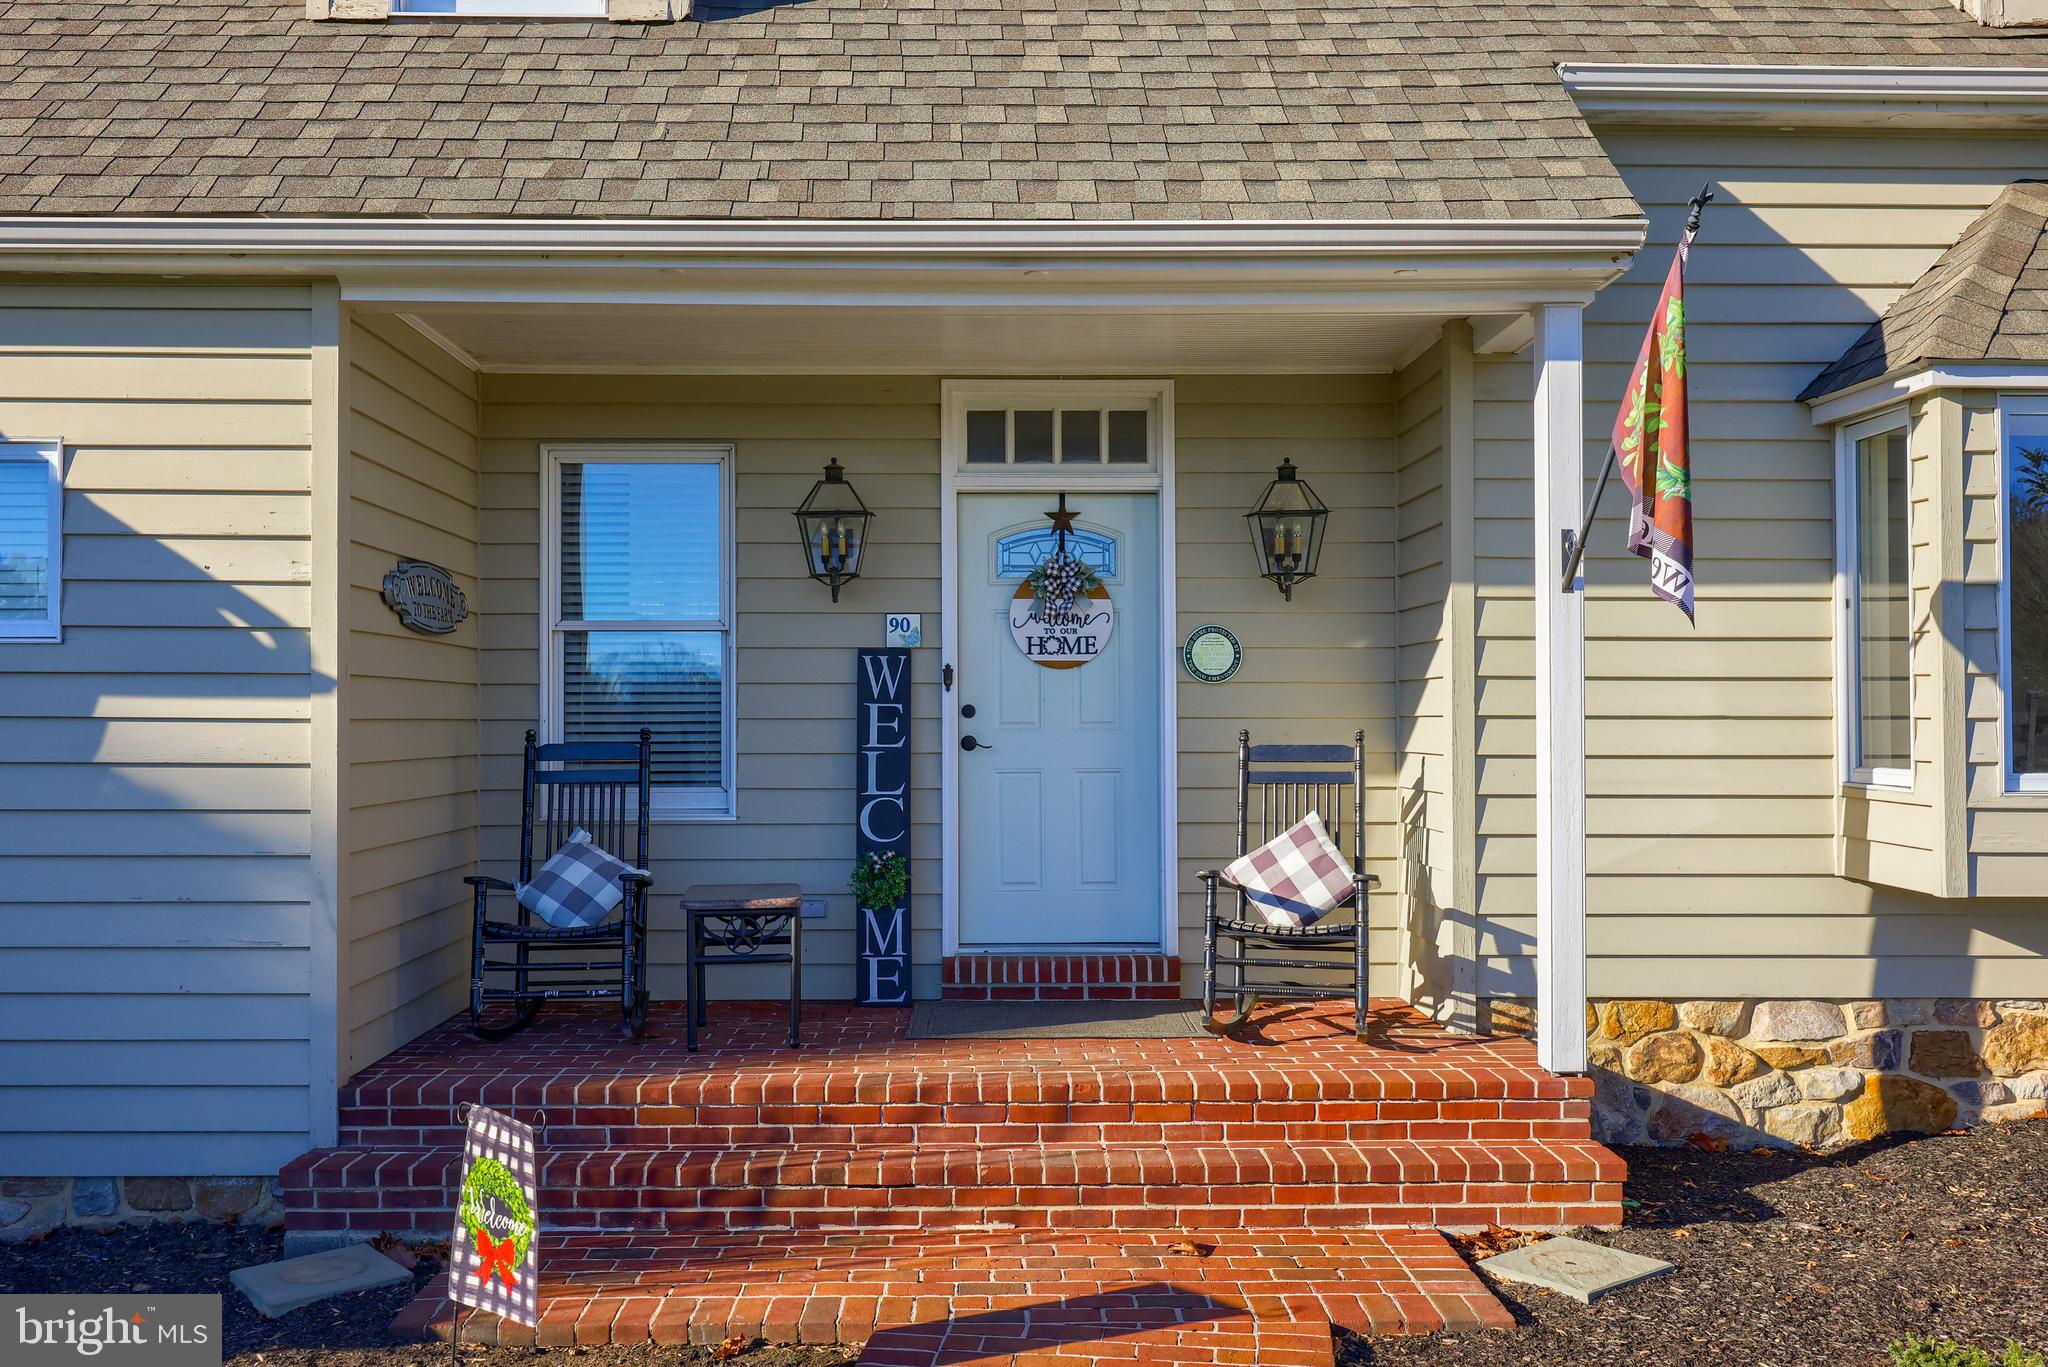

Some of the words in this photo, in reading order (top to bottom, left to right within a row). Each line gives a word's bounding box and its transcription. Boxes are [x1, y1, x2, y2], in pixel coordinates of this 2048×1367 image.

[405, 574, 456, 609] WELCOME
[412, 601, 422, 617] TO
[423, 603, 437, 621] THE
[889, 617, 910, 633] 90
[1025, 635, 1099, 656] HOME
[1192, 628, 1207, 641] HOME
[1207, 627, 1237, 645] PROTECTED
[1207, 659, 1239, 681] AMENDMENT
[468, 1185, 529, 1237] Welcome
